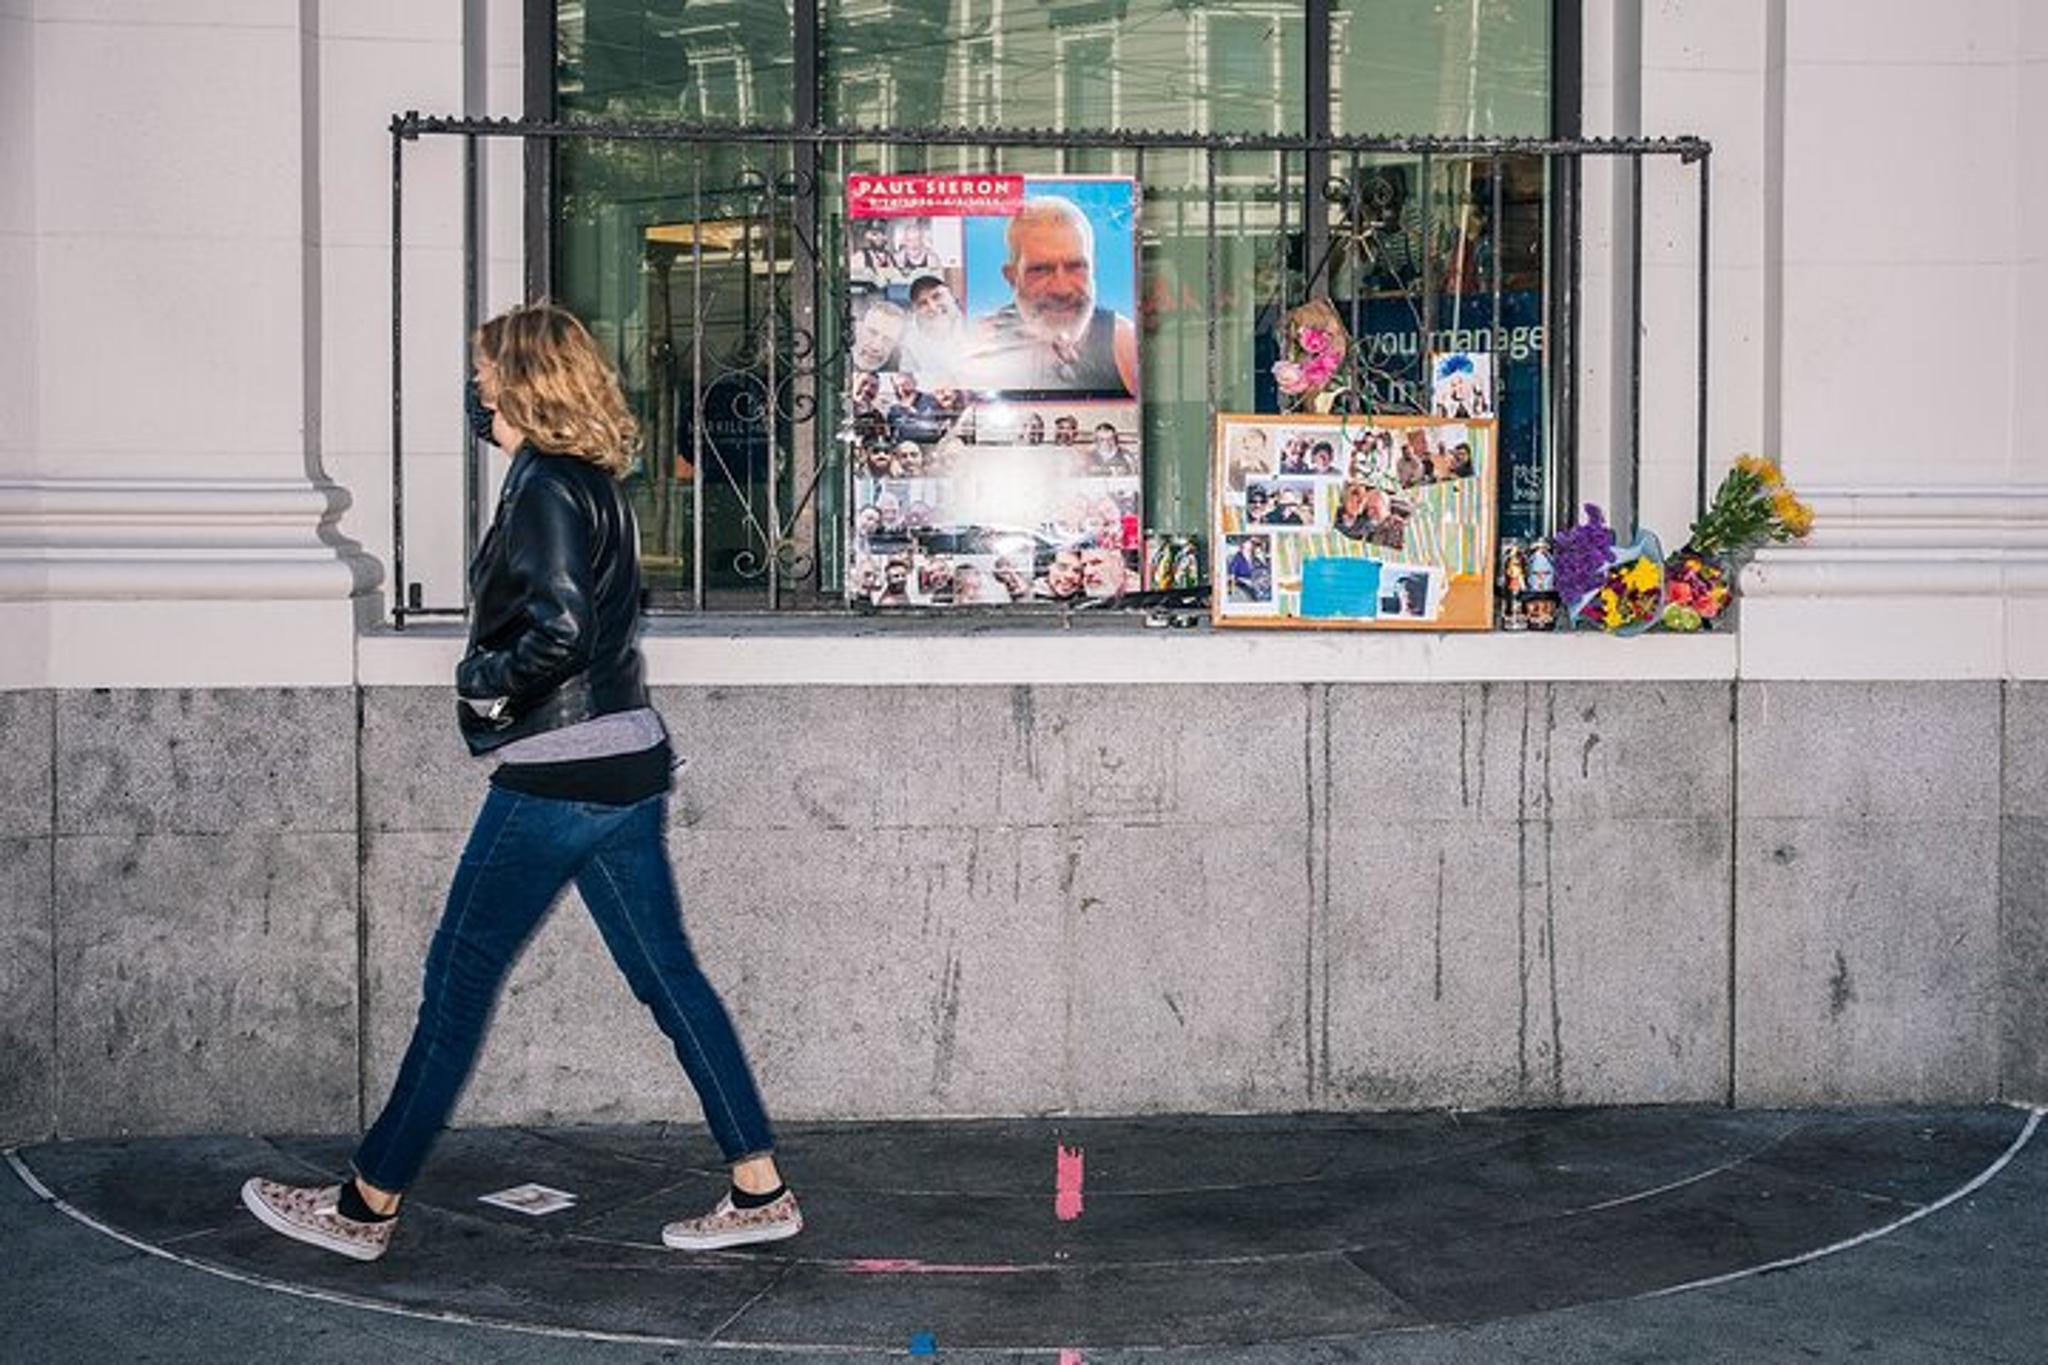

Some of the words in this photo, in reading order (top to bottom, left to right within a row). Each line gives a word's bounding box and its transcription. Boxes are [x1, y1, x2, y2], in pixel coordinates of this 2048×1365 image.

[858, 180, 917, 195] PAUL
[926, 180, 1010, 195] SIERON
[1366, 330, 1418, 360] you
[1429, 325, 1544, 360] manage
